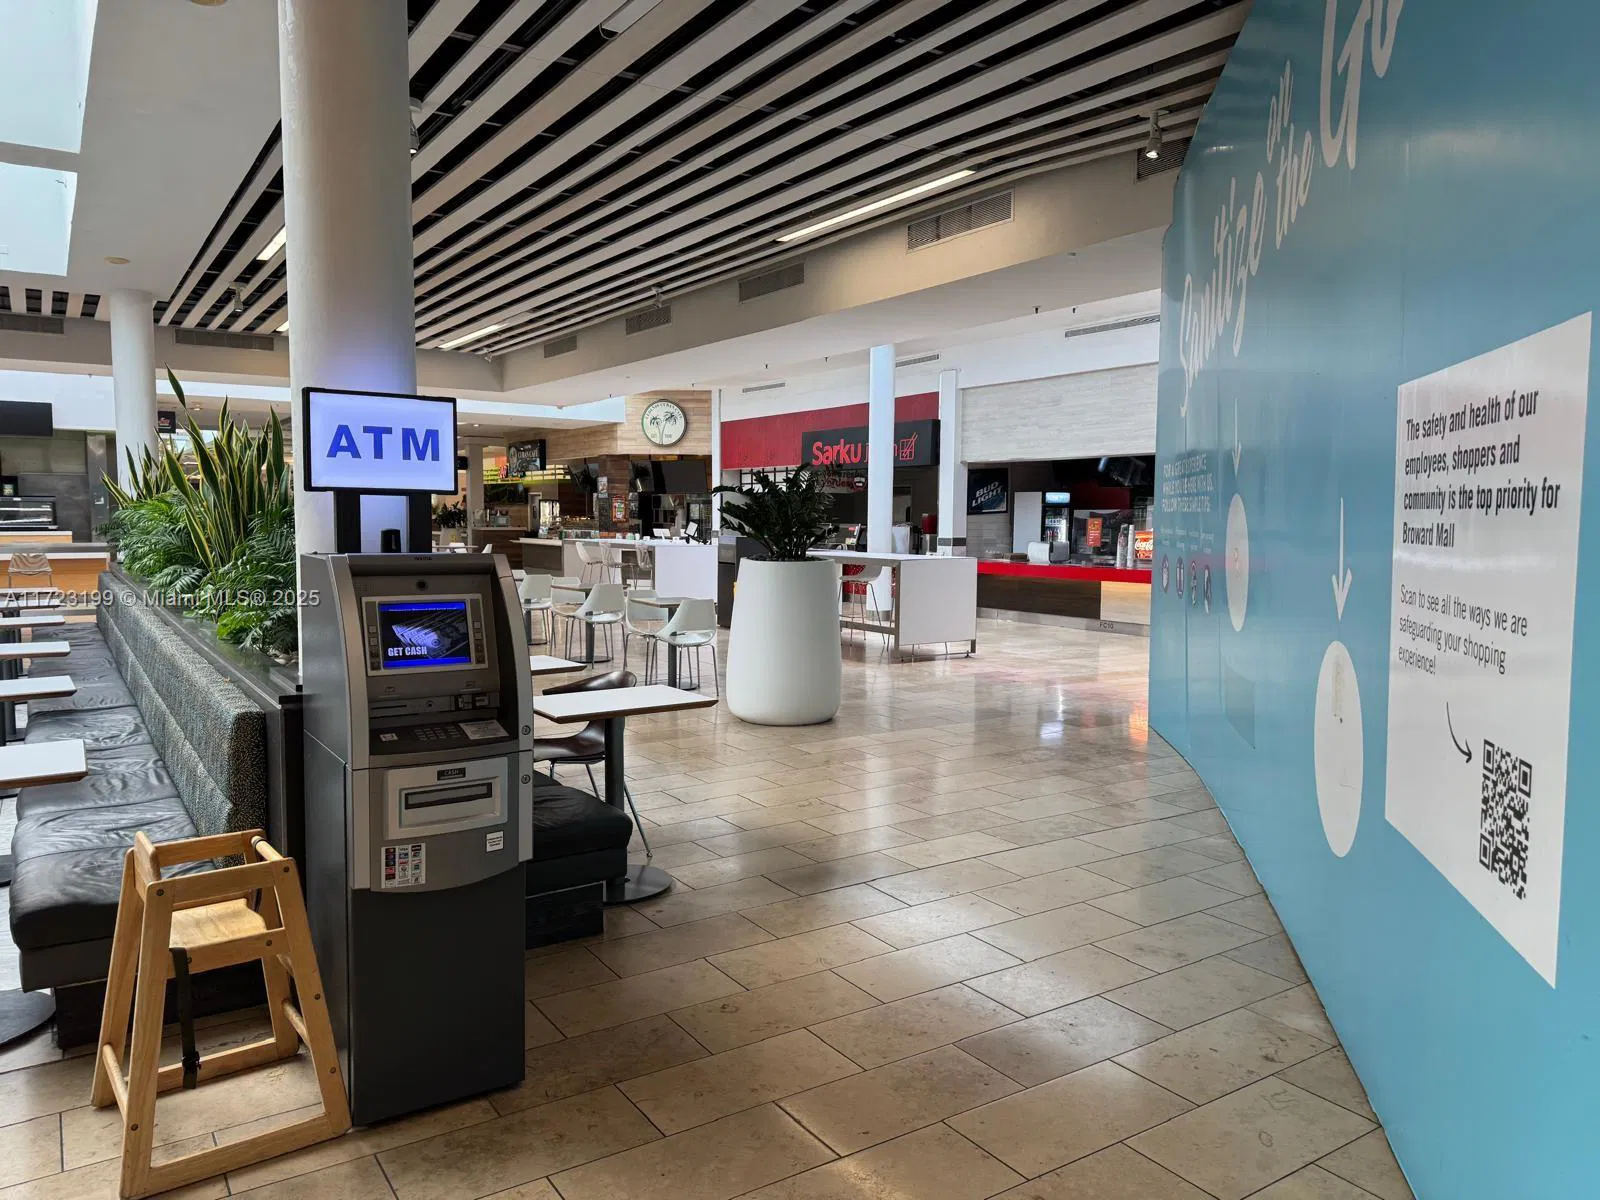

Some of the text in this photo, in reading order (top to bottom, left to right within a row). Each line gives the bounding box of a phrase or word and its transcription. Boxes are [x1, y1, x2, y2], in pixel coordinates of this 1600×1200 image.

[1179, 172, 1268, 417] Sanitize
[1275, 123, 1316, 250] the
[1406, 390, 1539, 441] The safety and health of our
[326, 424, 440, 461] ATM
[812, 438, 862, 466] Sarku
[1405, 434, 1520, 480] employees, shoppers and
[972, 486, 1003, 507] LIGHT
[976, 482, 999, 498] BUD
[1403, 477, 1561, 516] community is the top priority for
[1402, 521, 1455, 548] Broward Mall
[1400, 584, 1528, 637] Scan to see all the ways we are
[387, 646, 428, 657] GET CASH
[1398, 646, 1436, 676] experience!
[1399, 614, 1507, 675] safeguarding your shopping
